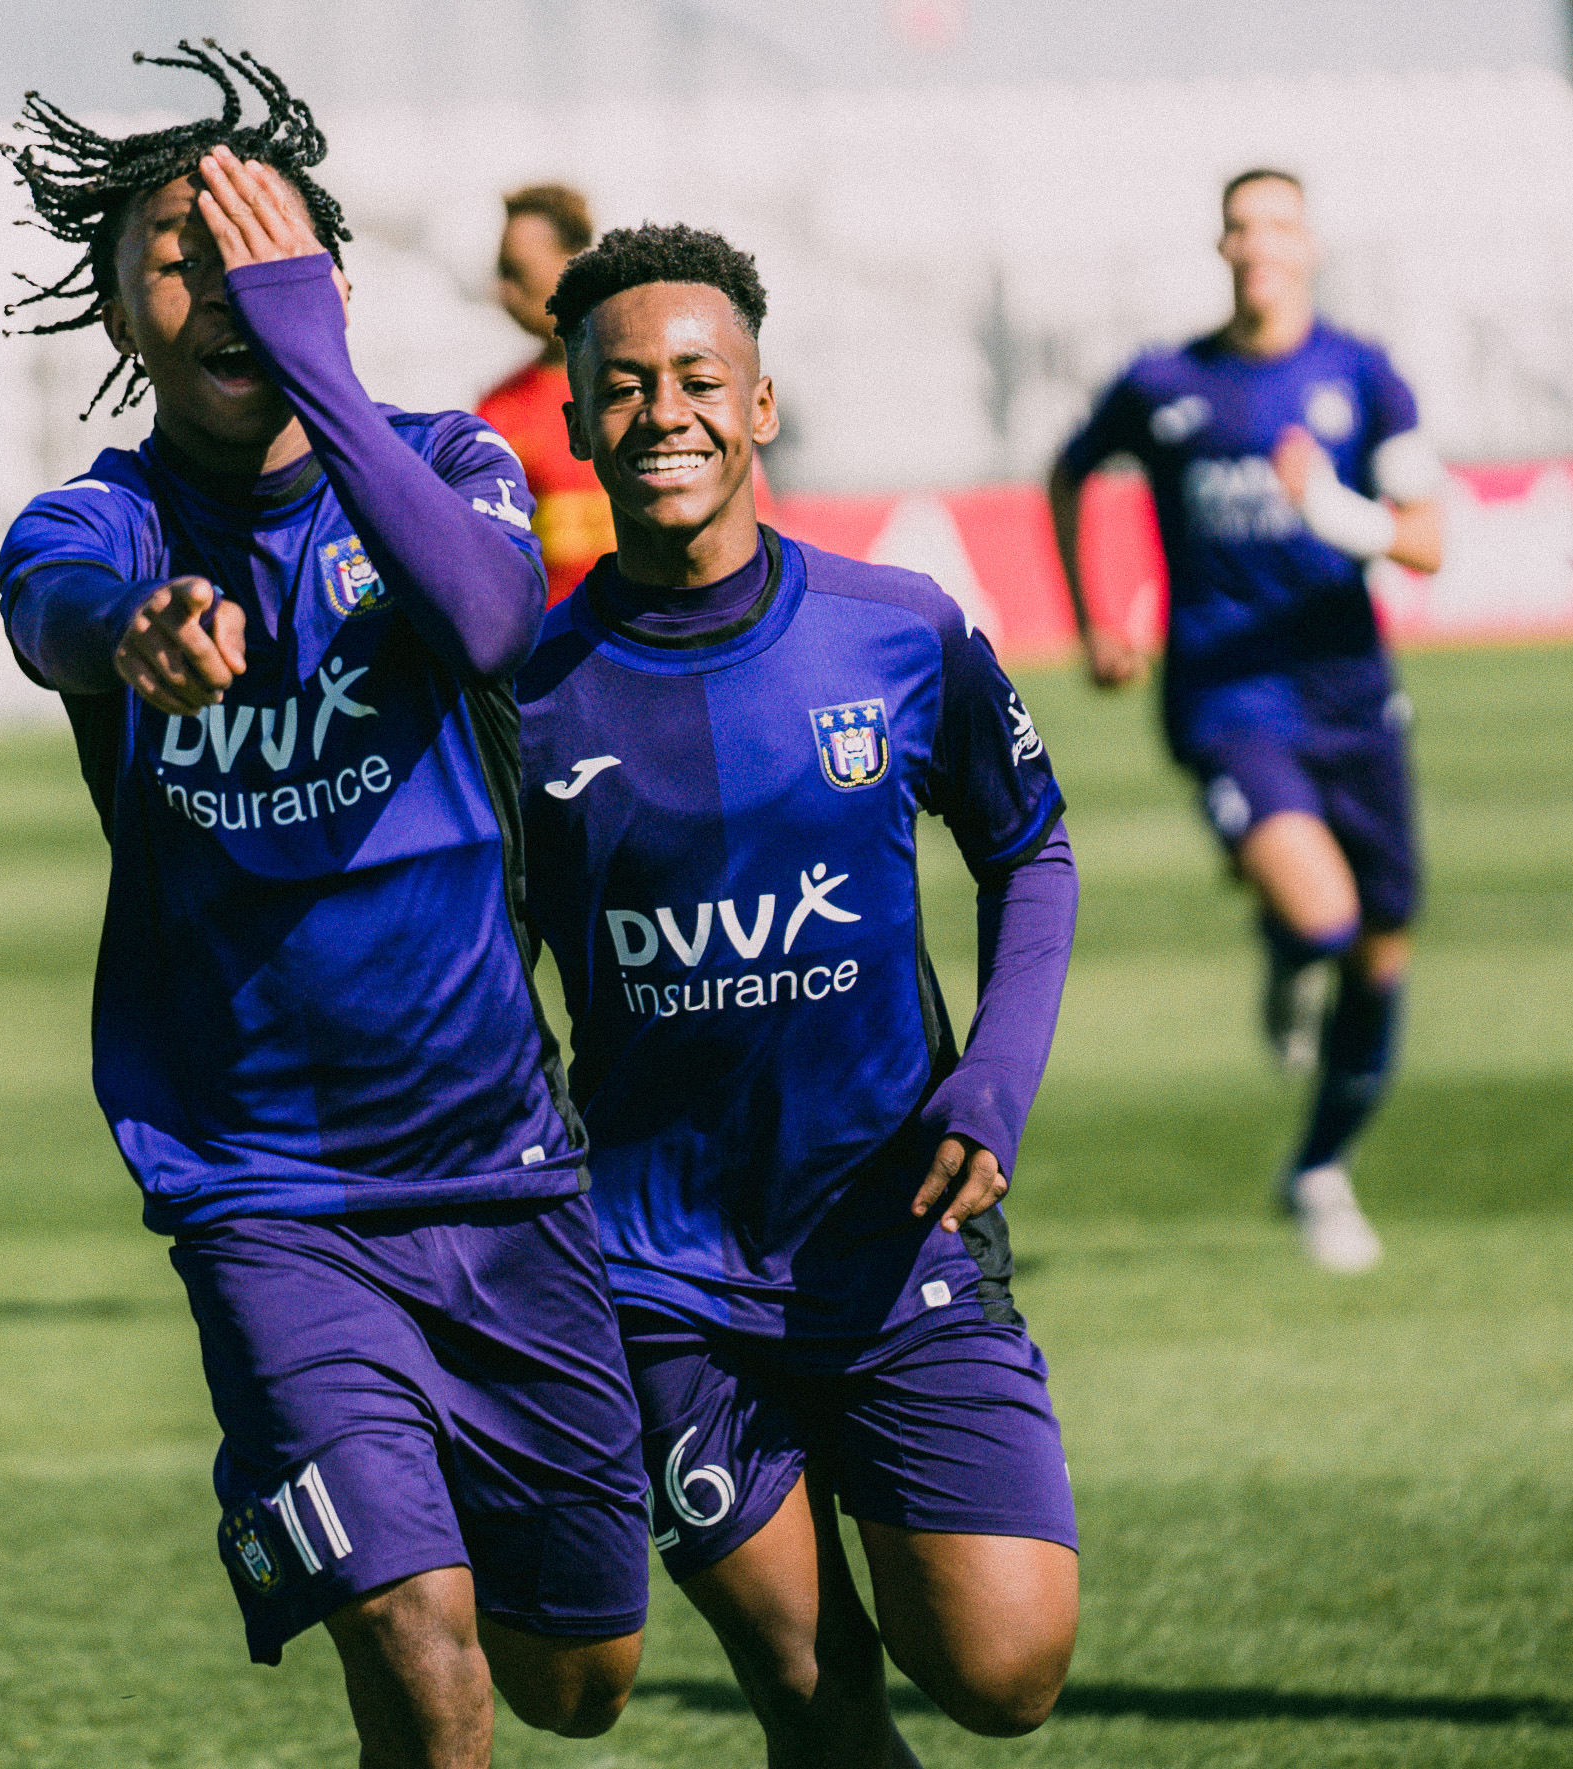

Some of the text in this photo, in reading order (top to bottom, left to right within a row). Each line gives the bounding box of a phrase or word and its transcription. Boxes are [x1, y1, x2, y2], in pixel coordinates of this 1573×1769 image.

[606, 893, 776, 967] DVV
[621, 959, 860, 1018] insurance
[270, 1461, 354, 1576] 11
